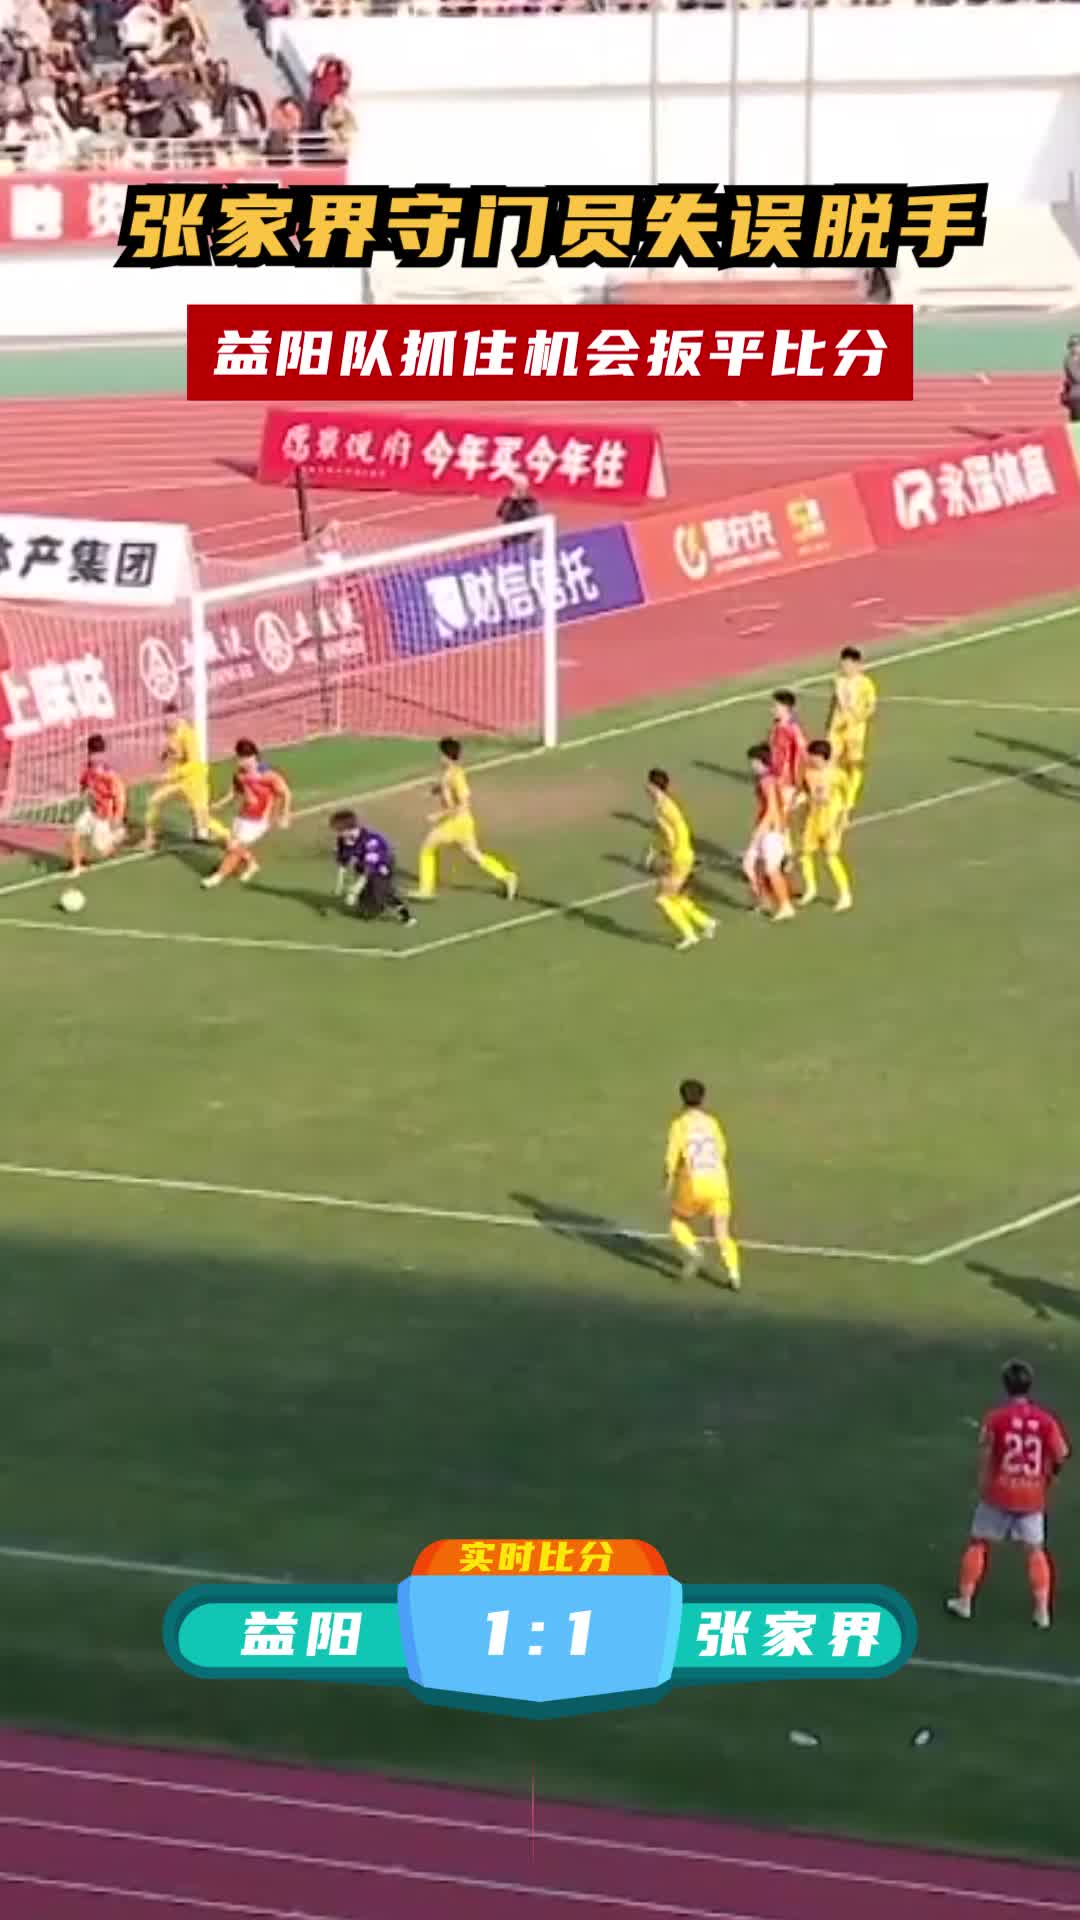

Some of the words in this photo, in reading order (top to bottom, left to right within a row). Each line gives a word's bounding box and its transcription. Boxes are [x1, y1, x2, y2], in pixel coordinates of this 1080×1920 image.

[422, 430, 628, 488] 今年买今年住
[1003, 1431, 1043, 1477] 23
